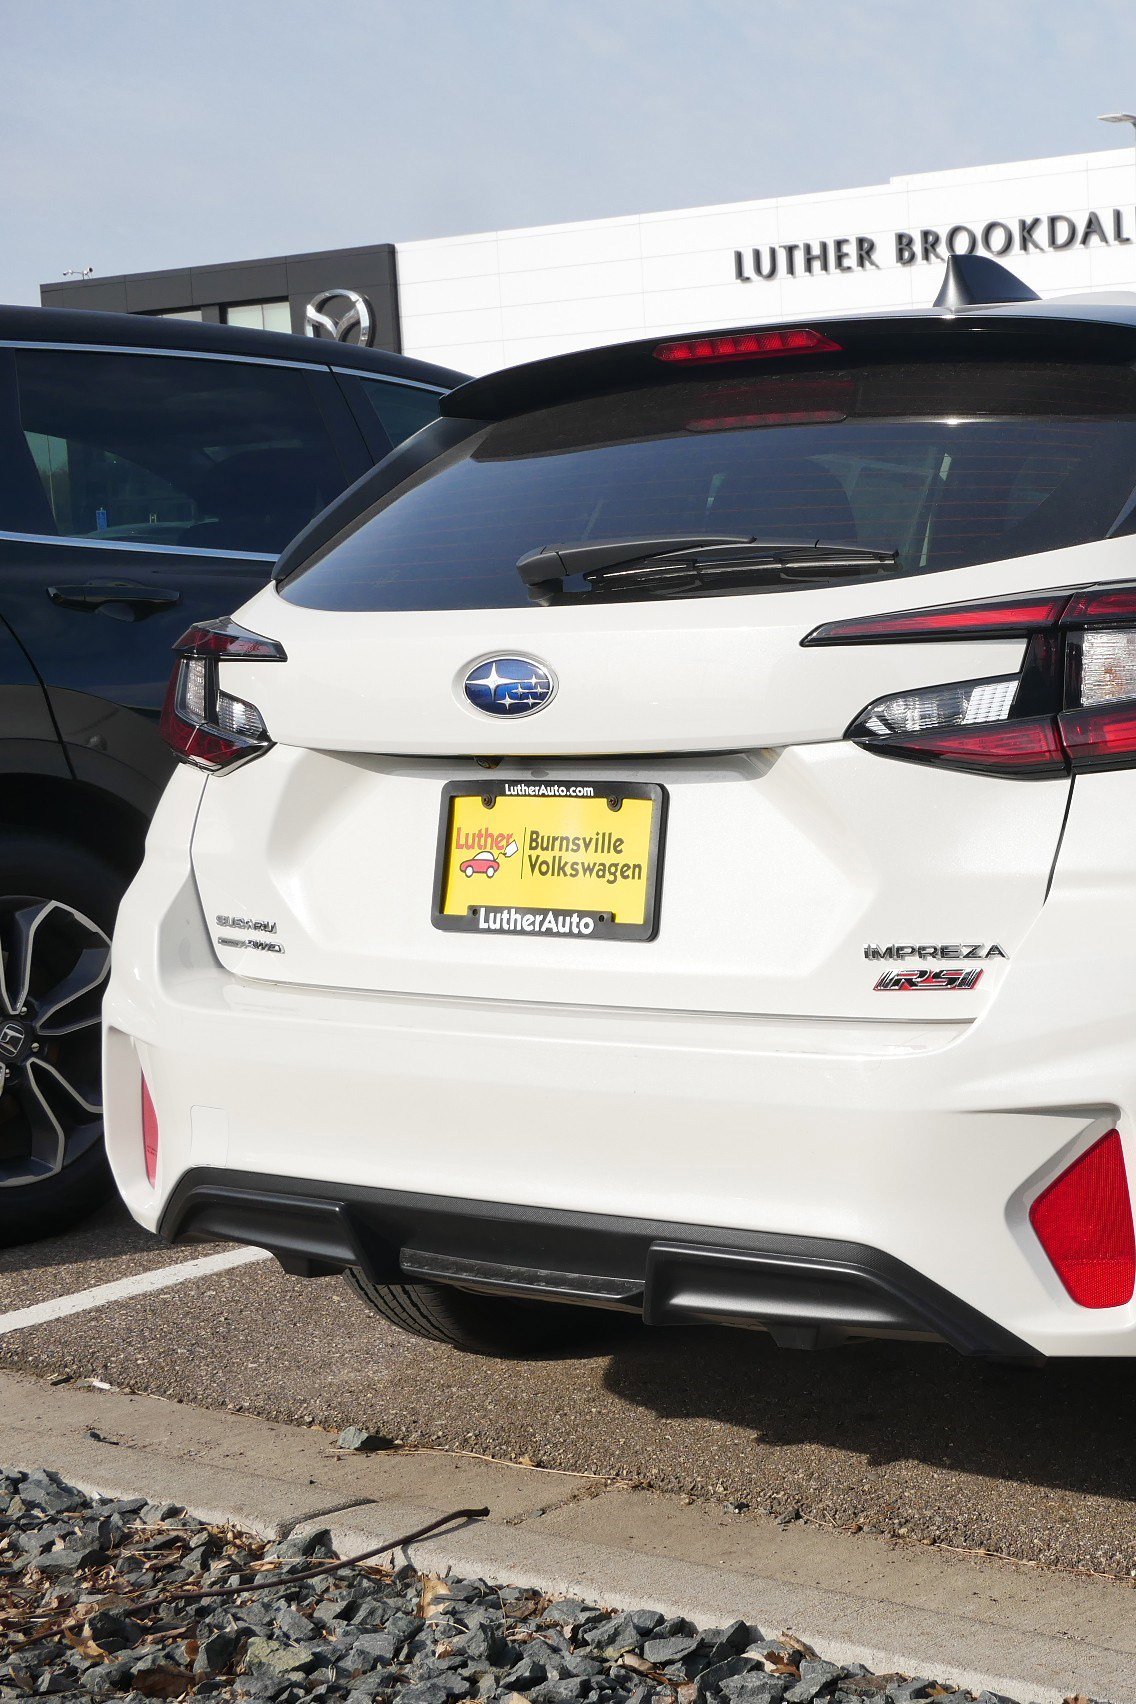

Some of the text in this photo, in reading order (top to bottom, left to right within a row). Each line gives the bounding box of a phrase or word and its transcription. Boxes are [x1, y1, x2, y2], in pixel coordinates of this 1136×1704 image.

[734, 235, 880, 281] LUTHER
[504, 784, 594, 797] LutherAuto.com
[455, 827, 514, 851] Luther
[528, 830, 625, 855] Burnsville
[528, 854, 642, 884] Volkswagen
[216, 914, 278, 934] SUBARU
[479, 907, 595, 935] LutherAuto
[863, 942, 1010, 962] IMPREZA
